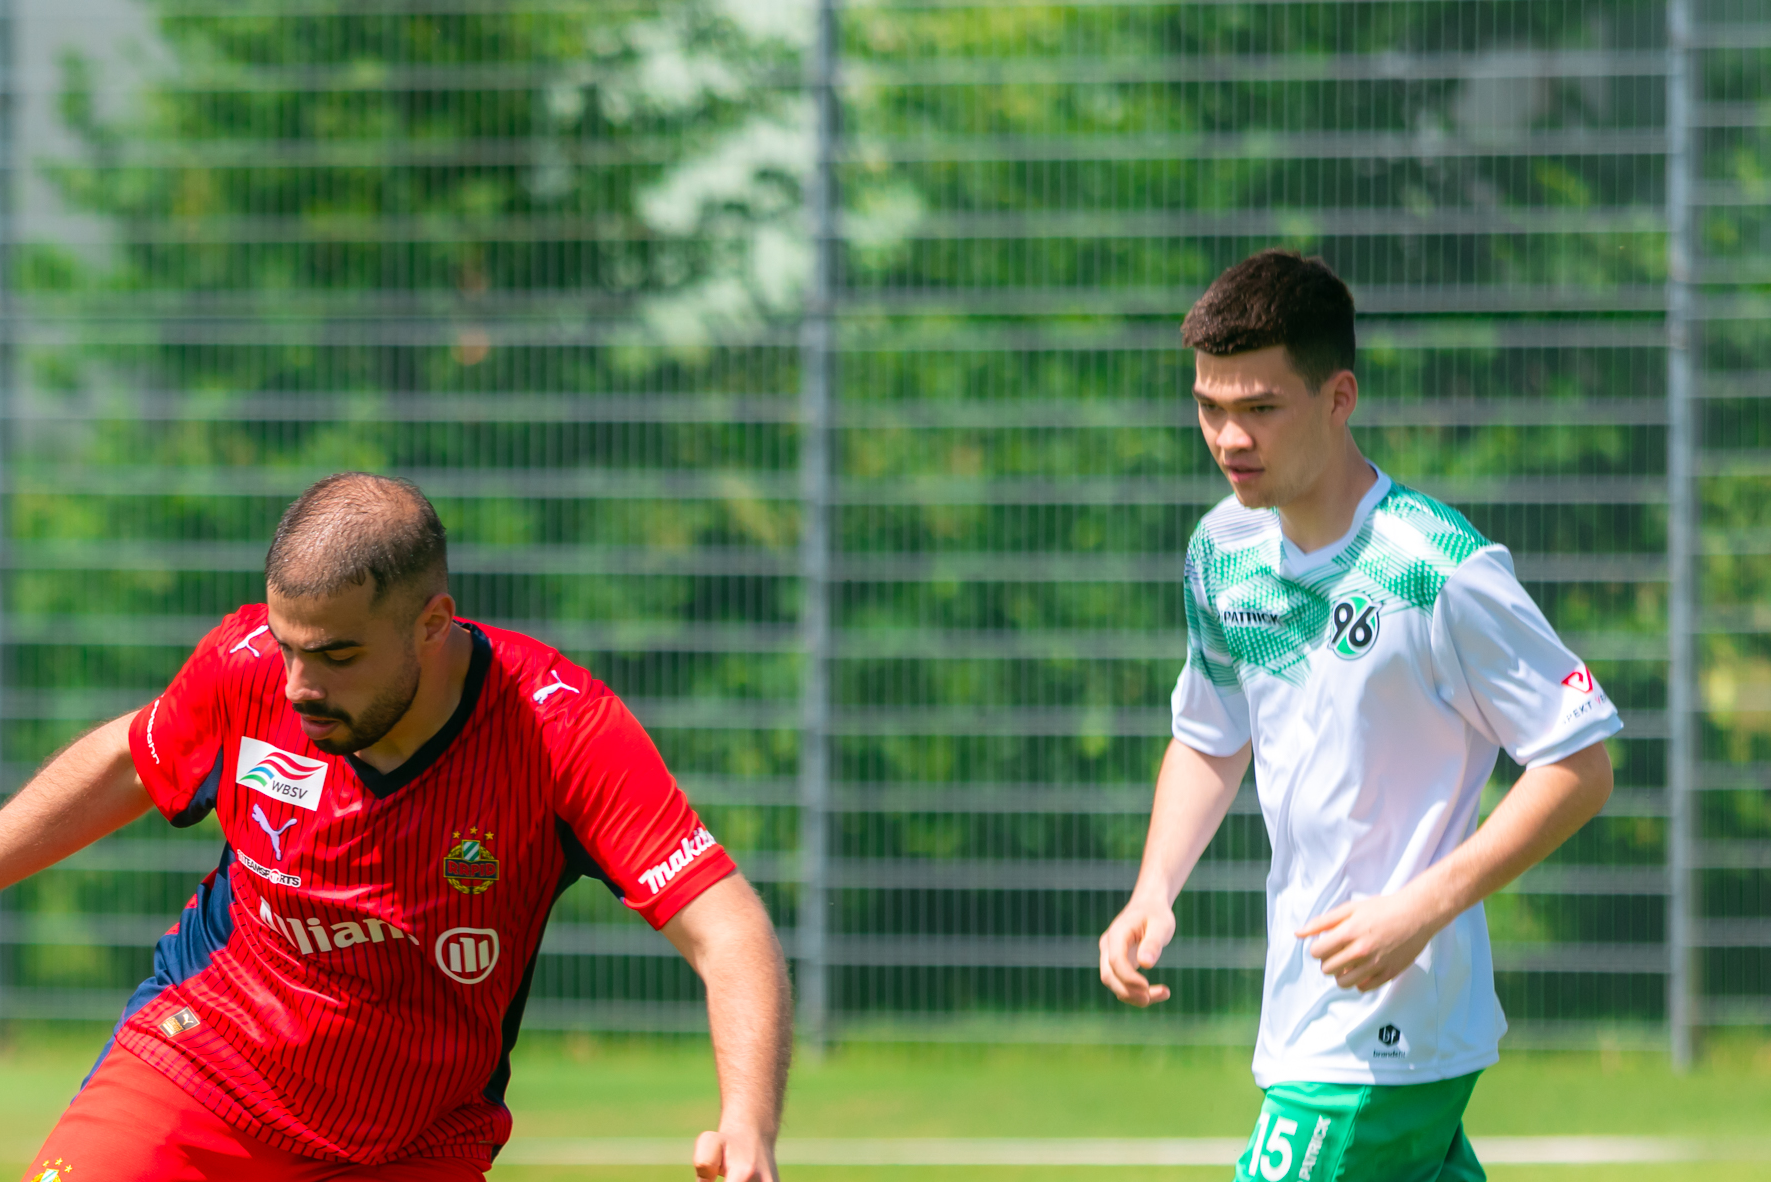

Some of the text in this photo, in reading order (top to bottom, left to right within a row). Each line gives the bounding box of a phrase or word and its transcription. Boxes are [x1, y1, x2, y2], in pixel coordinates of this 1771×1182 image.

[1332, 602, 1377, 648] 96
[271, 780, 308, 799] WBSV
[448, 860, 496, 877] RAPID
[259, 896, 420, 955] Allian
[1248, 1111, 1298, 1182] 15
[1298, 1114, 1331, 1181] PATRICK
